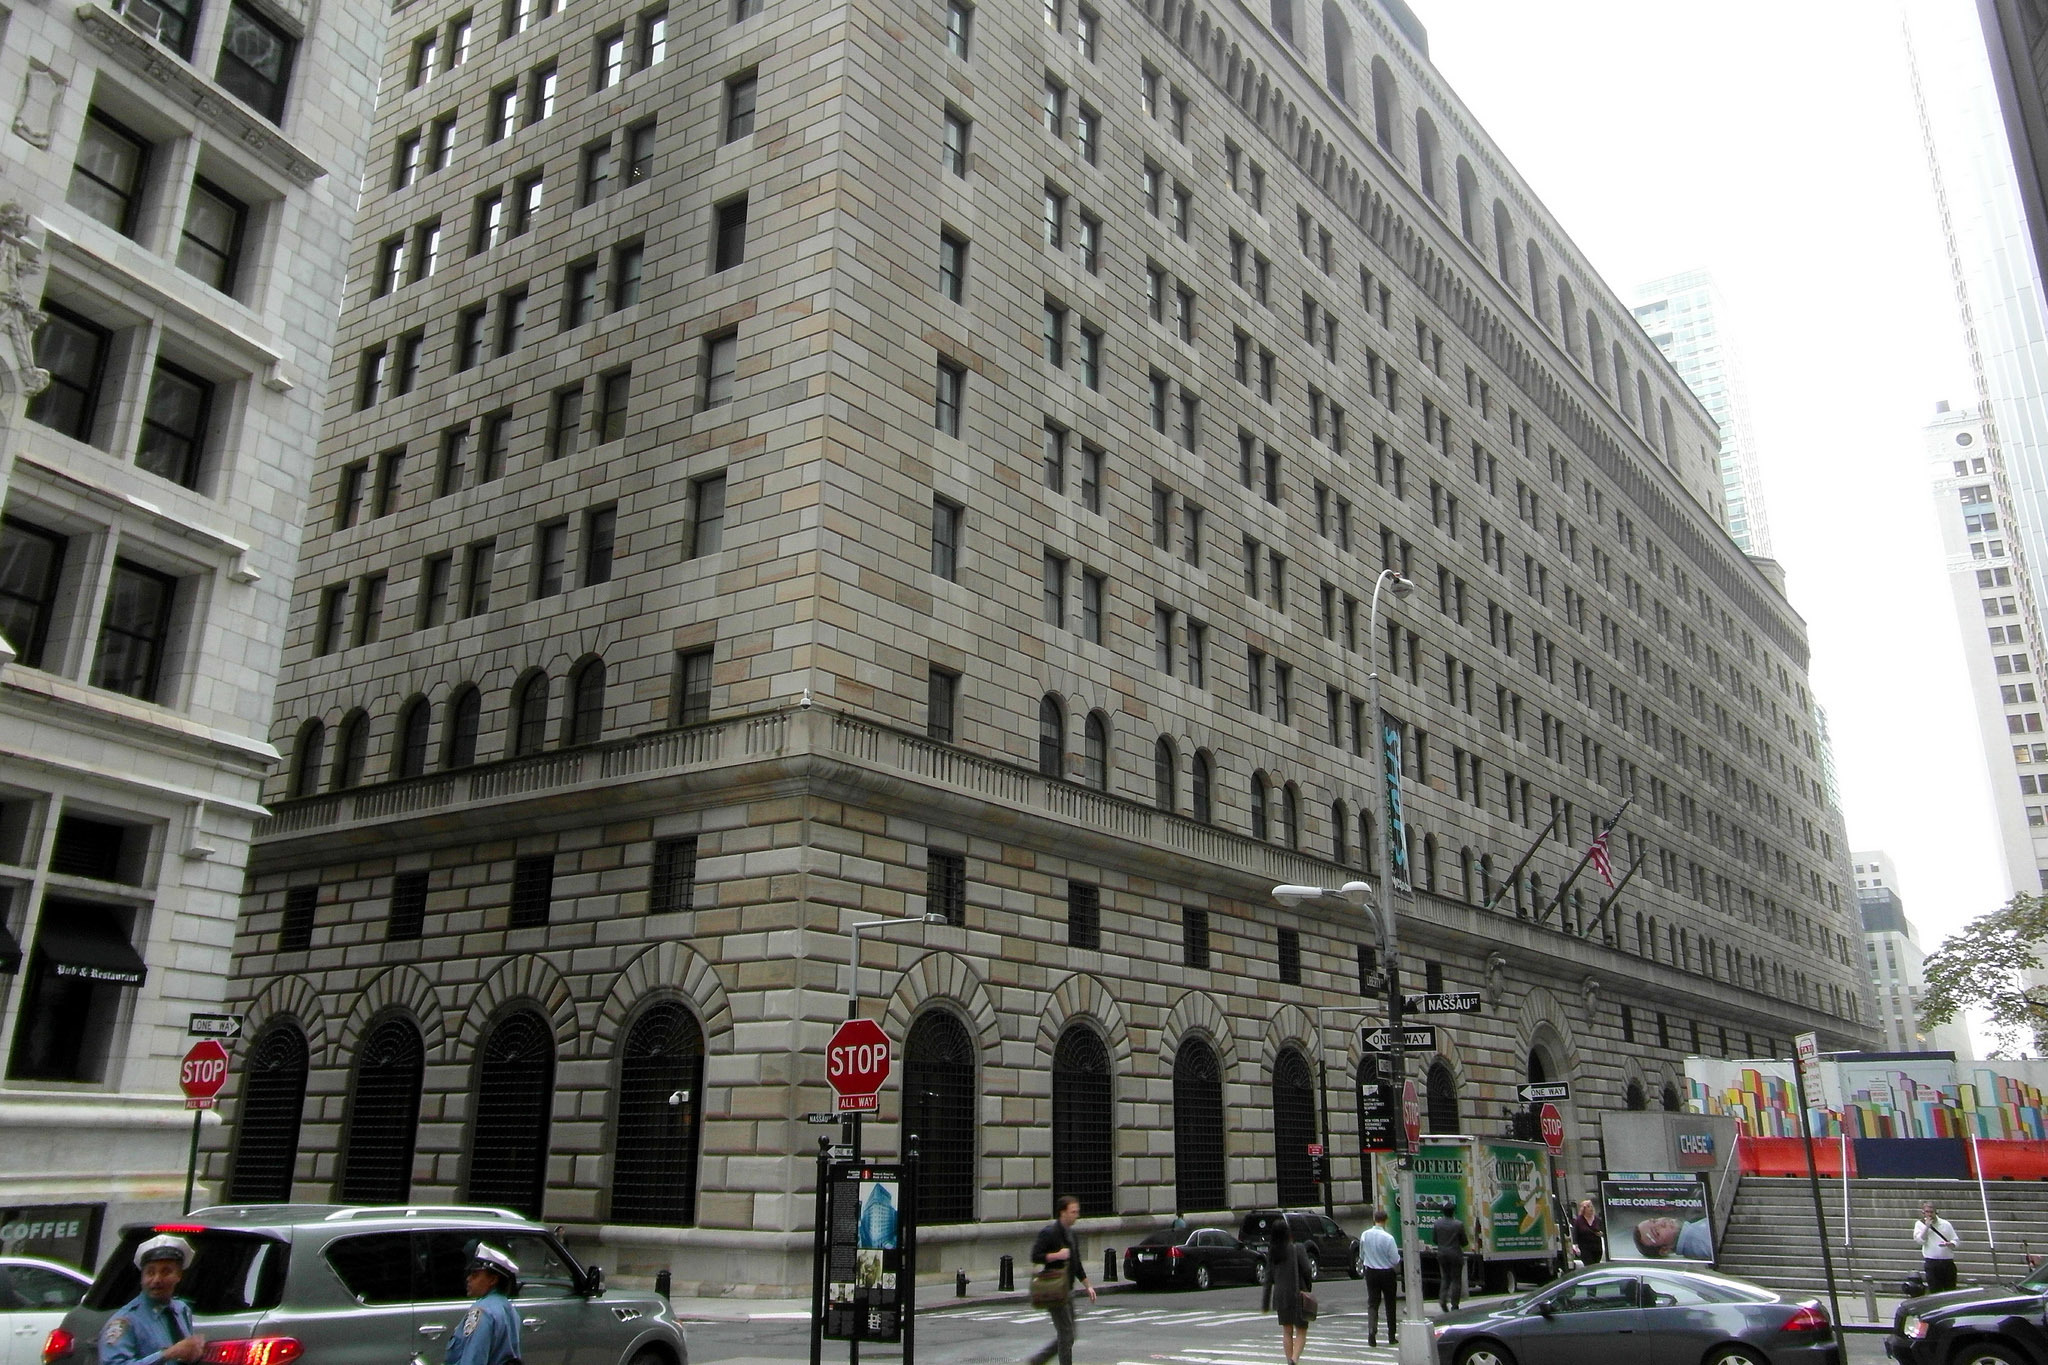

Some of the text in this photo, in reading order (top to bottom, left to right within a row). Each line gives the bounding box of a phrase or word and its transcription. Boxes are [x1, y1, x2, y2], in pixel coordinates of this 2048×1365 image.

[57, 964, 139, 981] Pub & Restaurant
[1428, 998, 1470, 1011] NASSAU
[196, 1020, 236, 1031] ONE WAY
[1404, 1034, 1426, 1044] WAY
[830, 1043, 887, 1076] STOP
[182, 1060, 225, 1084] STOP
[1530, 1087, 1564, 1096] ONE WAY
[840, 1097, 874, 1108] ALL WAY
[808, 1114, 828, 1123] NASSAU
[1404, 1101, 1419, 1126] STOP
[1543, 1119, 1562, 1136] STOP
[1680, 1135, 1708, 1153] CHASE
[1414, 1160, 1463, 1174] OFFEE
[1495, 1161, 1531, 1182] COFFEE
[1619, 1172, 1640, 1180] TITAN
[1608, 1198, 1632, 1206] HERE
[1632, 1198, 1666, 1207] COMES
[1675, 1199, 1703, 1207] BOOM
[0, 1221, 80, 1241] COFFEE
